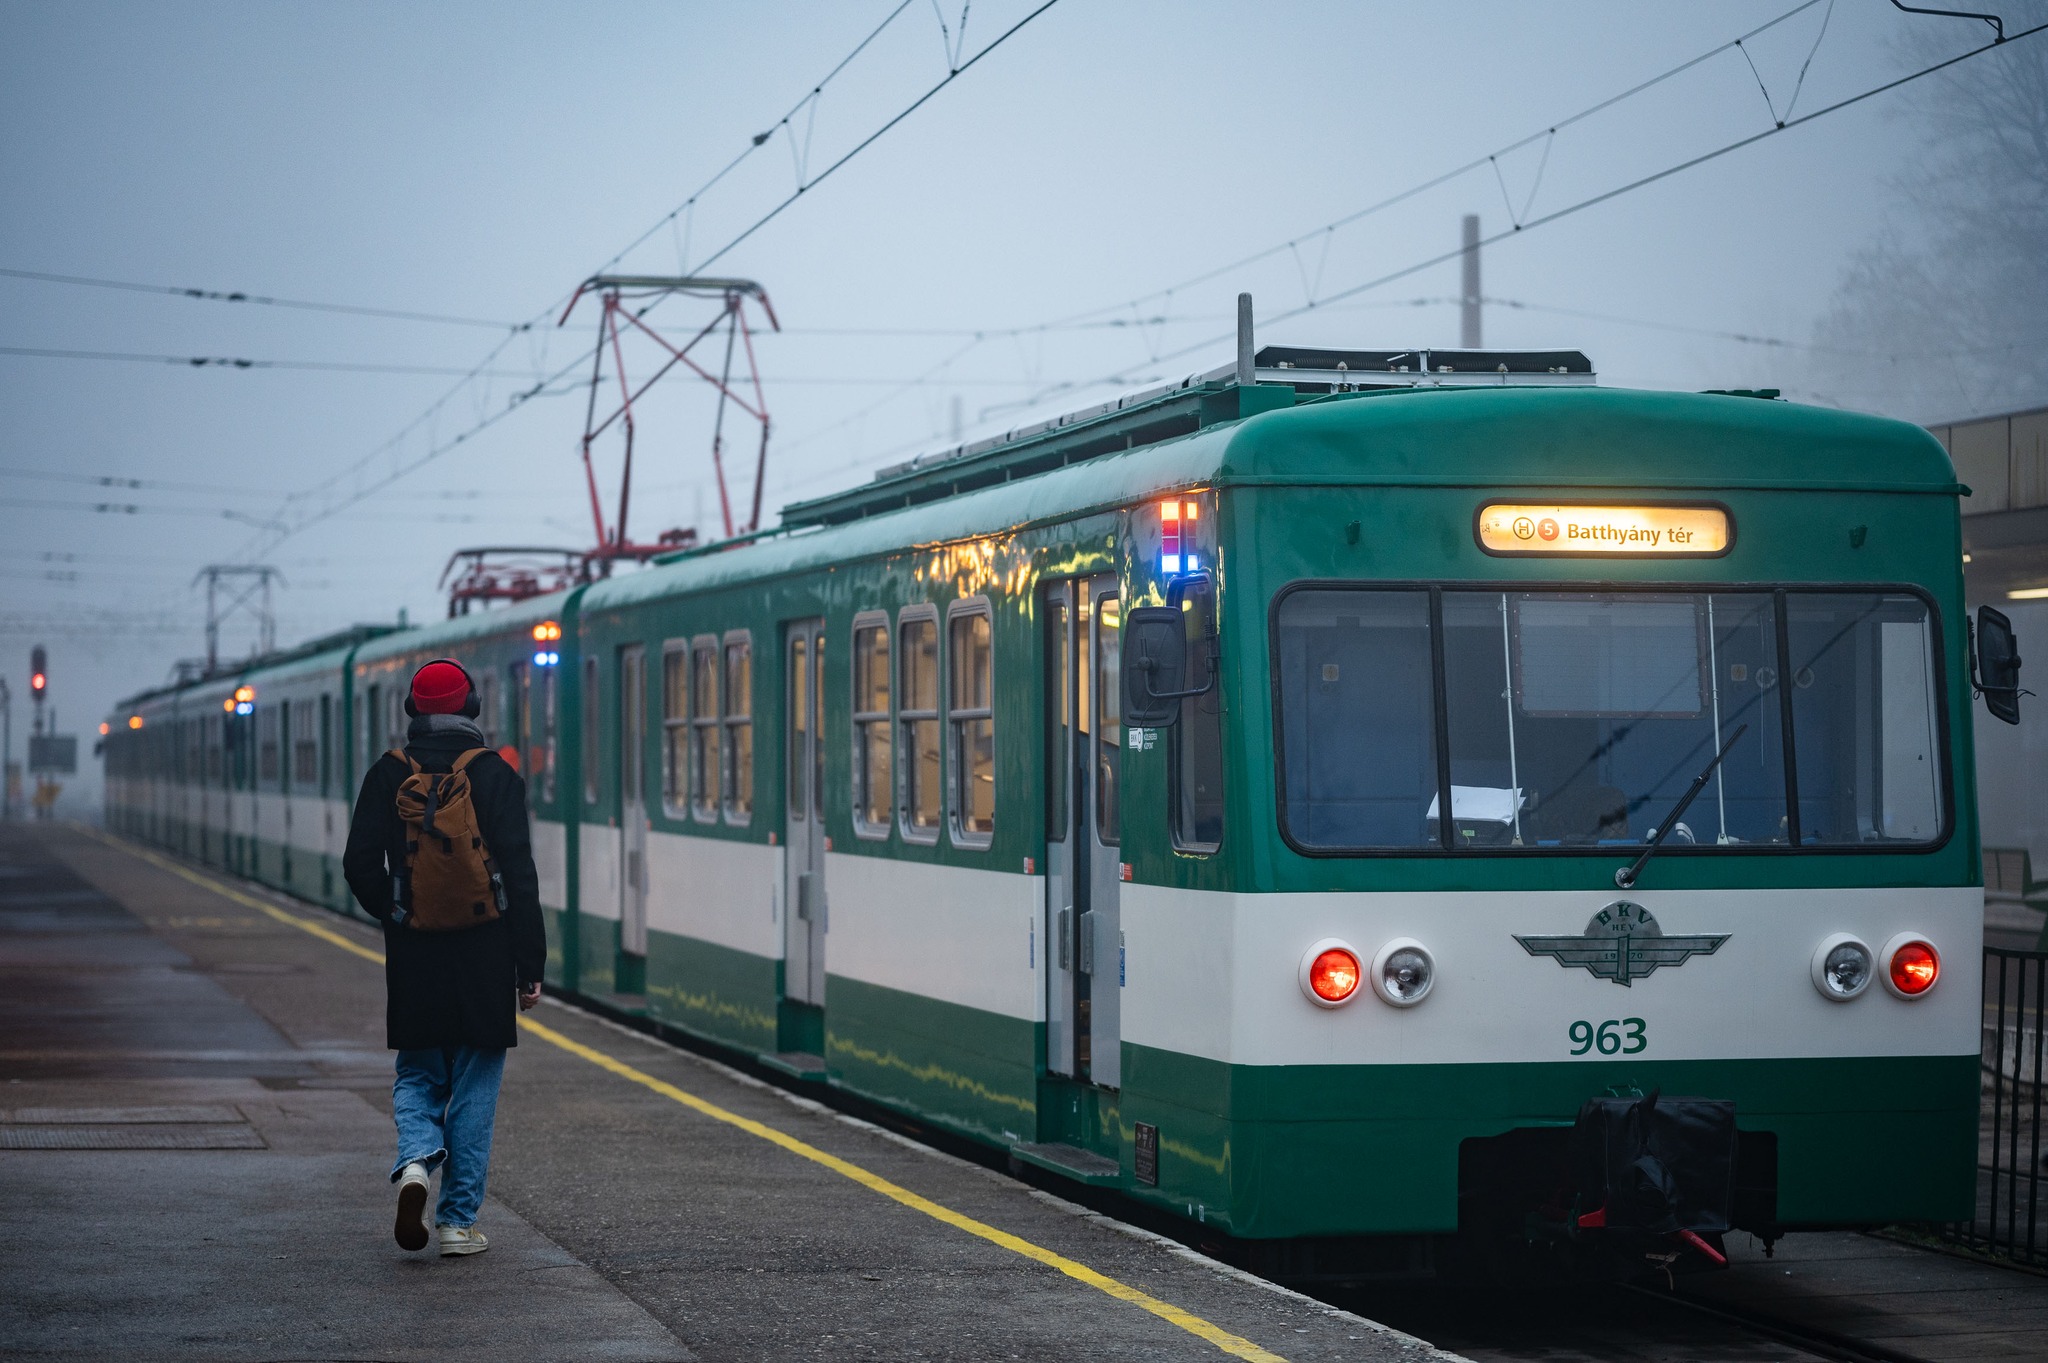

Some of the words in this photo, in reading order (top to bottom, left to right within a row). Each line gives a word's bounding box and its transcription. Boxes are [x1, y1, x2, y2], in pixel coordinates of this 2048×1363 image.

[1568, 523, 1661, 546] Batthyány
[1669, 526, 1693, 543] tér
[1596, 904, 1653, 926] BKV
[1568, 1017, 1648, 1056] 963
